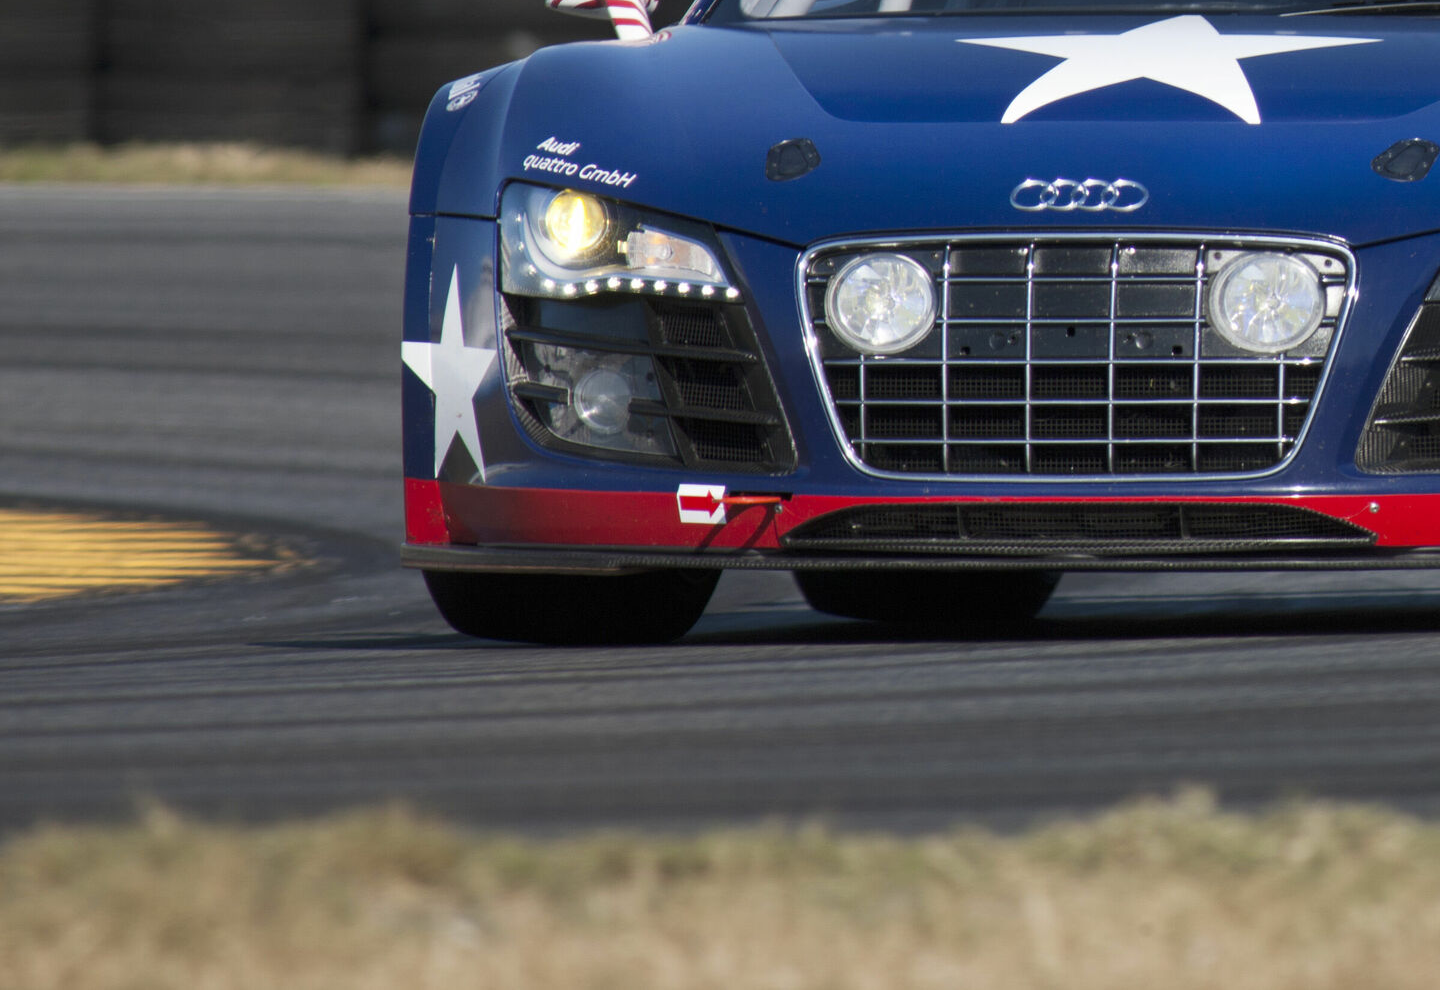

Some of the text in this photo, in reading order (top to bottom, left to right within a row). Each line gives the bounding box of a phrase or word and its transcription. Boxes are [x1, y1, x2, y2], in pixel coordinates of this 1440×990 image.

[537, 136, 580, 156] Audi
[523, 154, 637, 188] quattro GmbH
